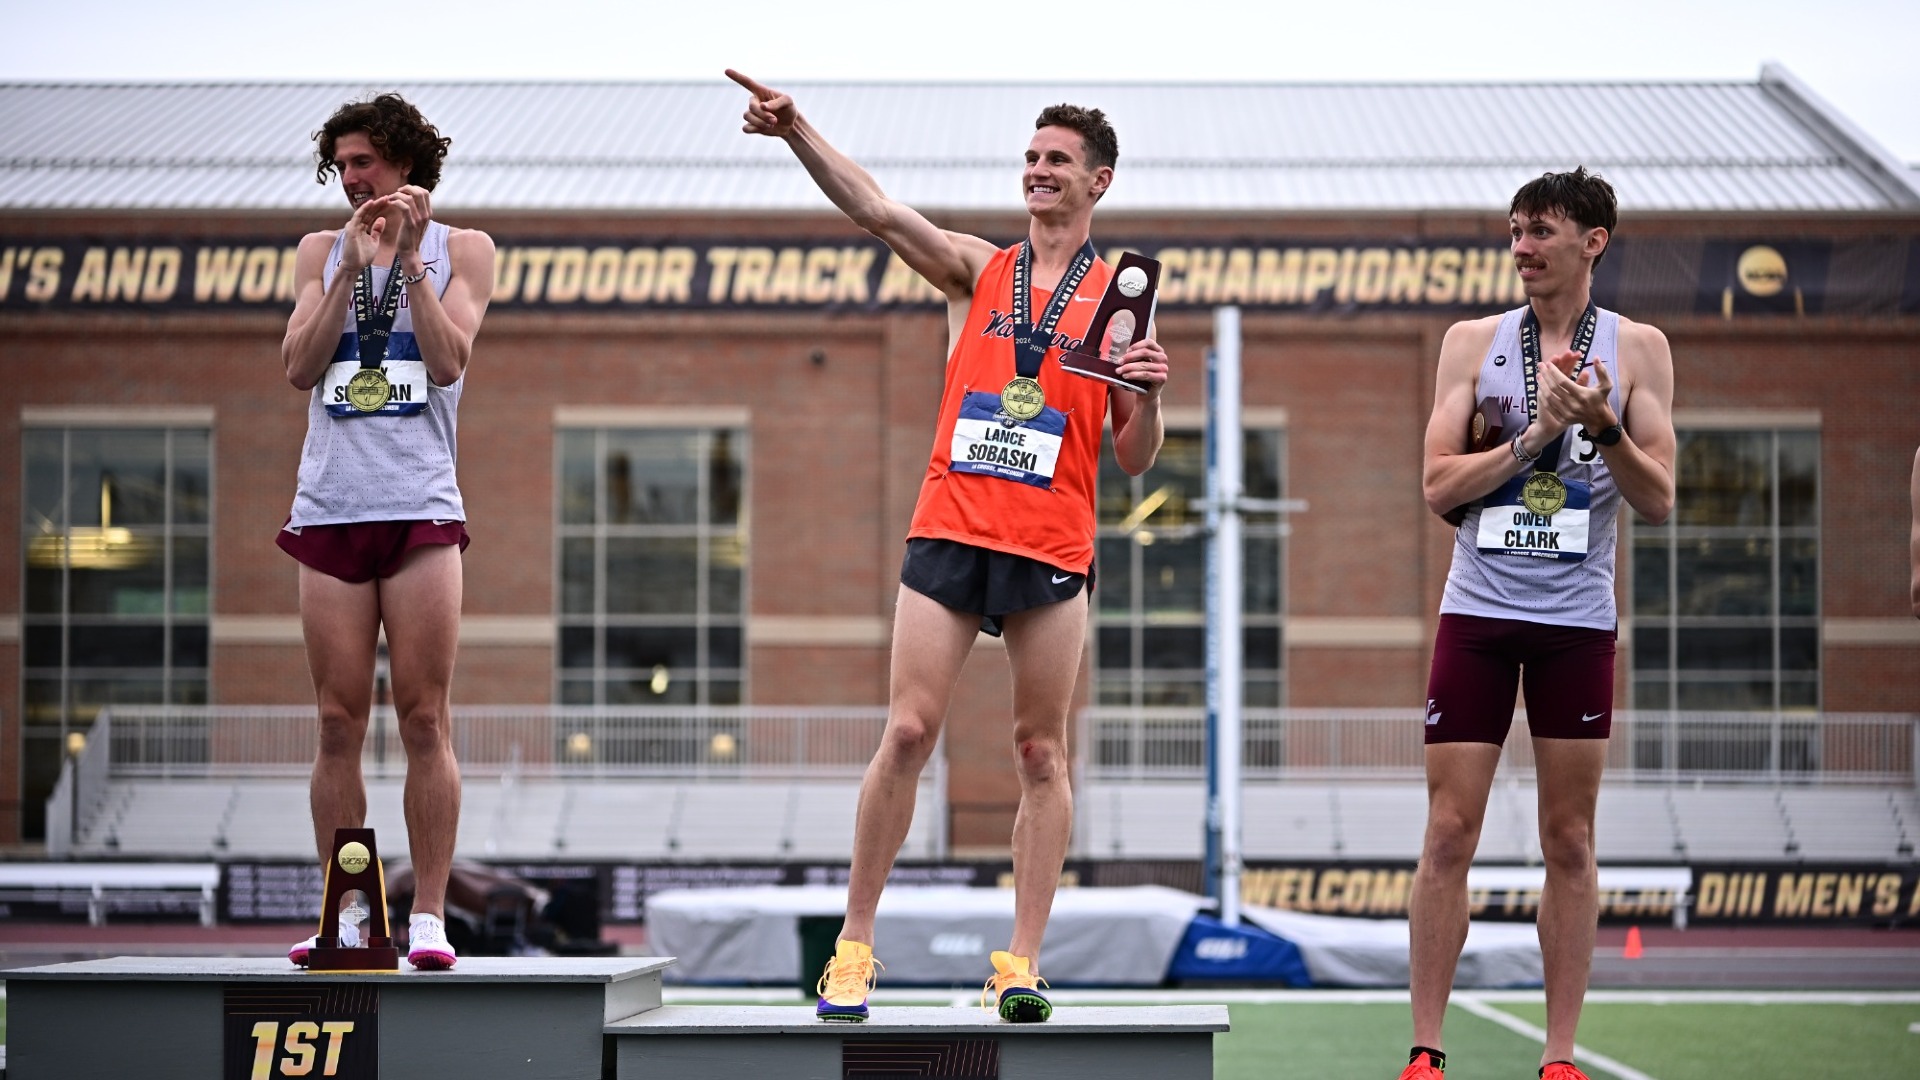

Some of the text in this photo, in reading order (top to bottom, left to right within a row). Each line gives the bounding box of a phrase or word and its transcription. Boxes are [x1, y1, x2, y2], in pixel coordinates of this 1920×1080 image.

[70, 247, 182, 302] AND
[492, 247, 696, 303] UTDOOR
[705, 247, 876, 303] TRACK
[985, 428, 1027, 446] LANCE
[967, 443, 1038, 471] SOBASKI
[1513, 512, 1552, 527] OWEN
[1504, 530, 1560, 549] CLARK
[341, 857, 369, 866] NCAA
[1242, 869, 1413, 915] WELCOM
[1696, 872, 1767, 917] DIII
[1774, 872, 1902, 917] MEN'S
[251, 1021, 355, 1080] 1ST
